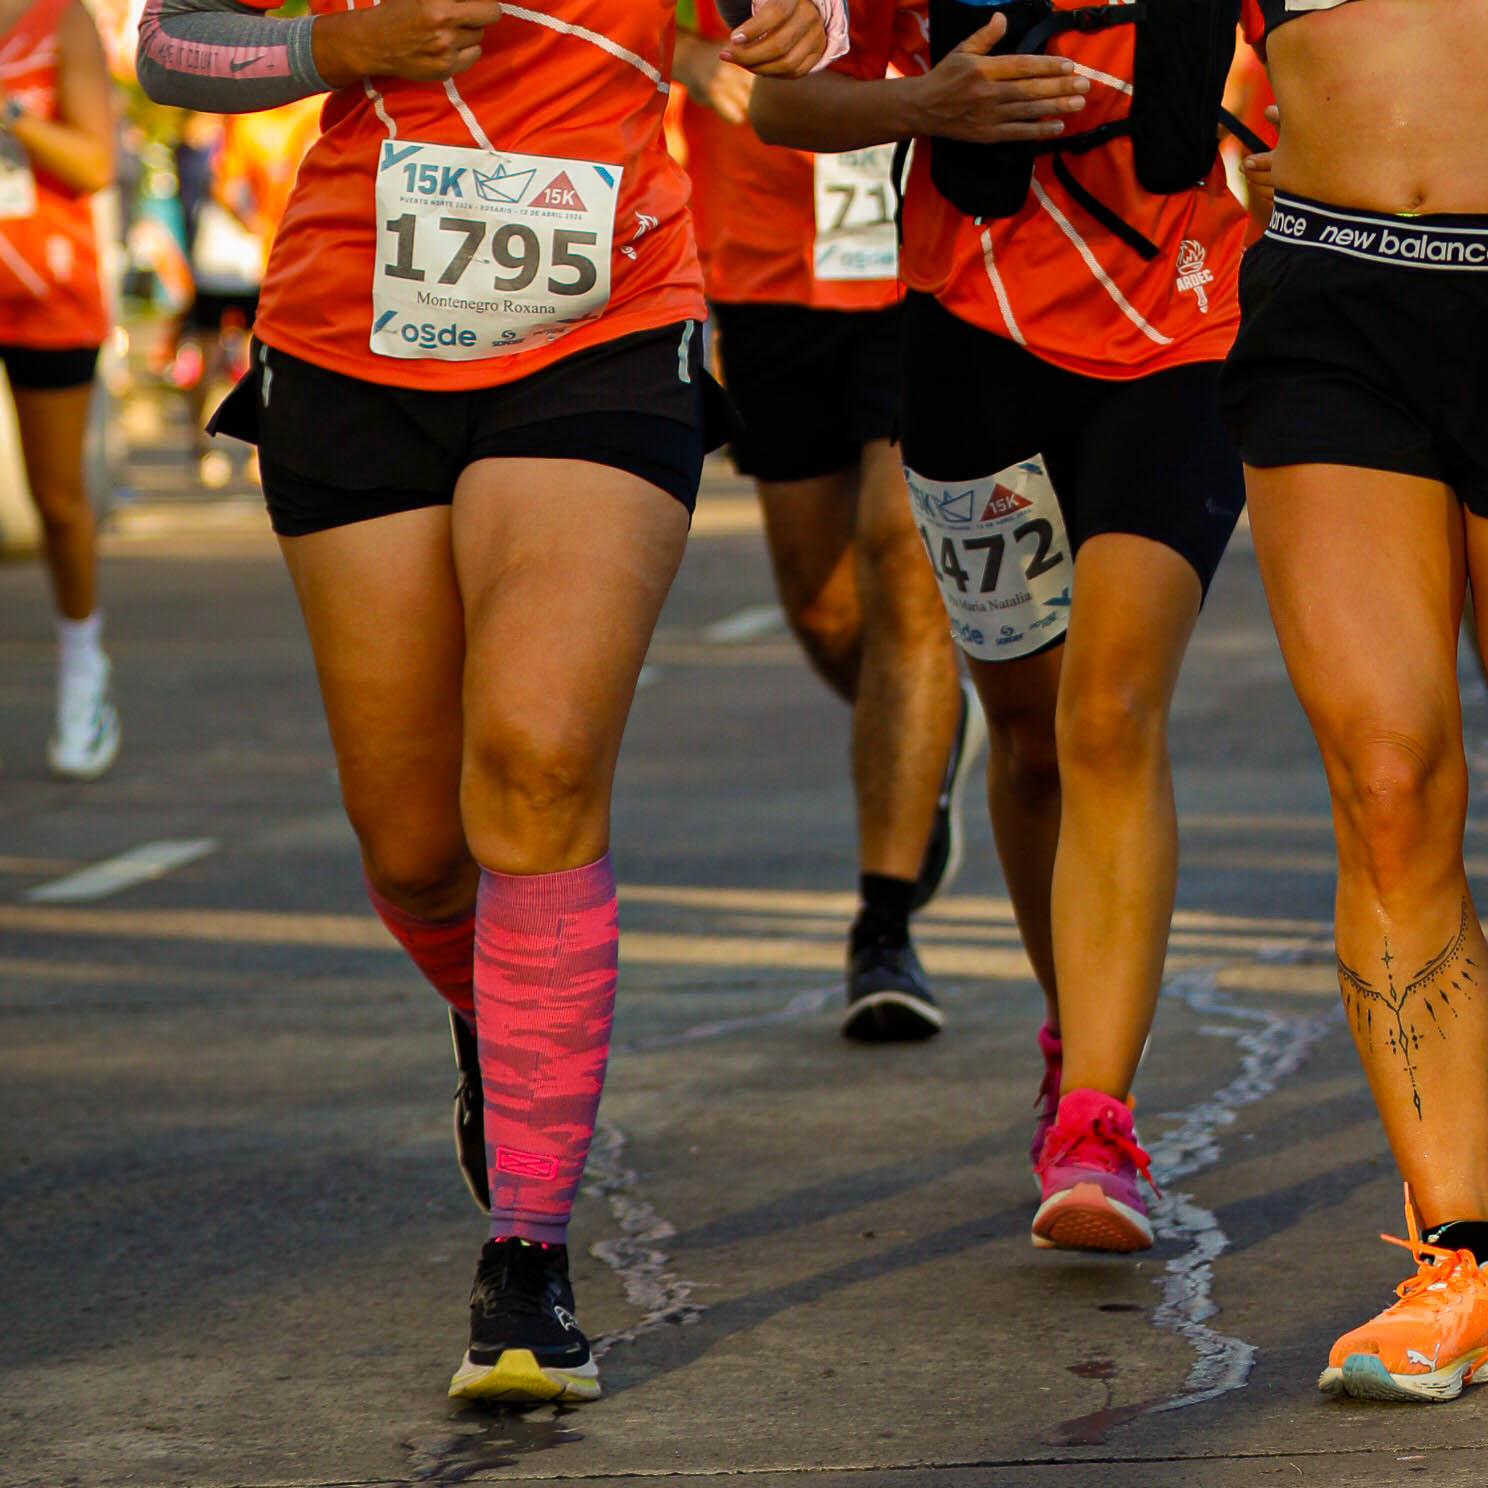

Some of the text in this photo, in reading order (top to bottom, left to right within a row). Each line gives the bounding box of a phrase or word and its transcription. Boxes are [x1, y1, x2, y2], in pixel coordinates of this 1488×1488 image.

[403, 163, 467, 198] 15K
[543, 187, 577, 207] 15K
[1319, 224, 1377, 251] new
[384, 213, 598, 296] 1795
[1176, 269, 1214, 292] ARDEC
[416, 290, 556, 315] Montenegro Roxana
[401, 323, 477, 349] osde
[988, 492, 1020, 514] 15K
